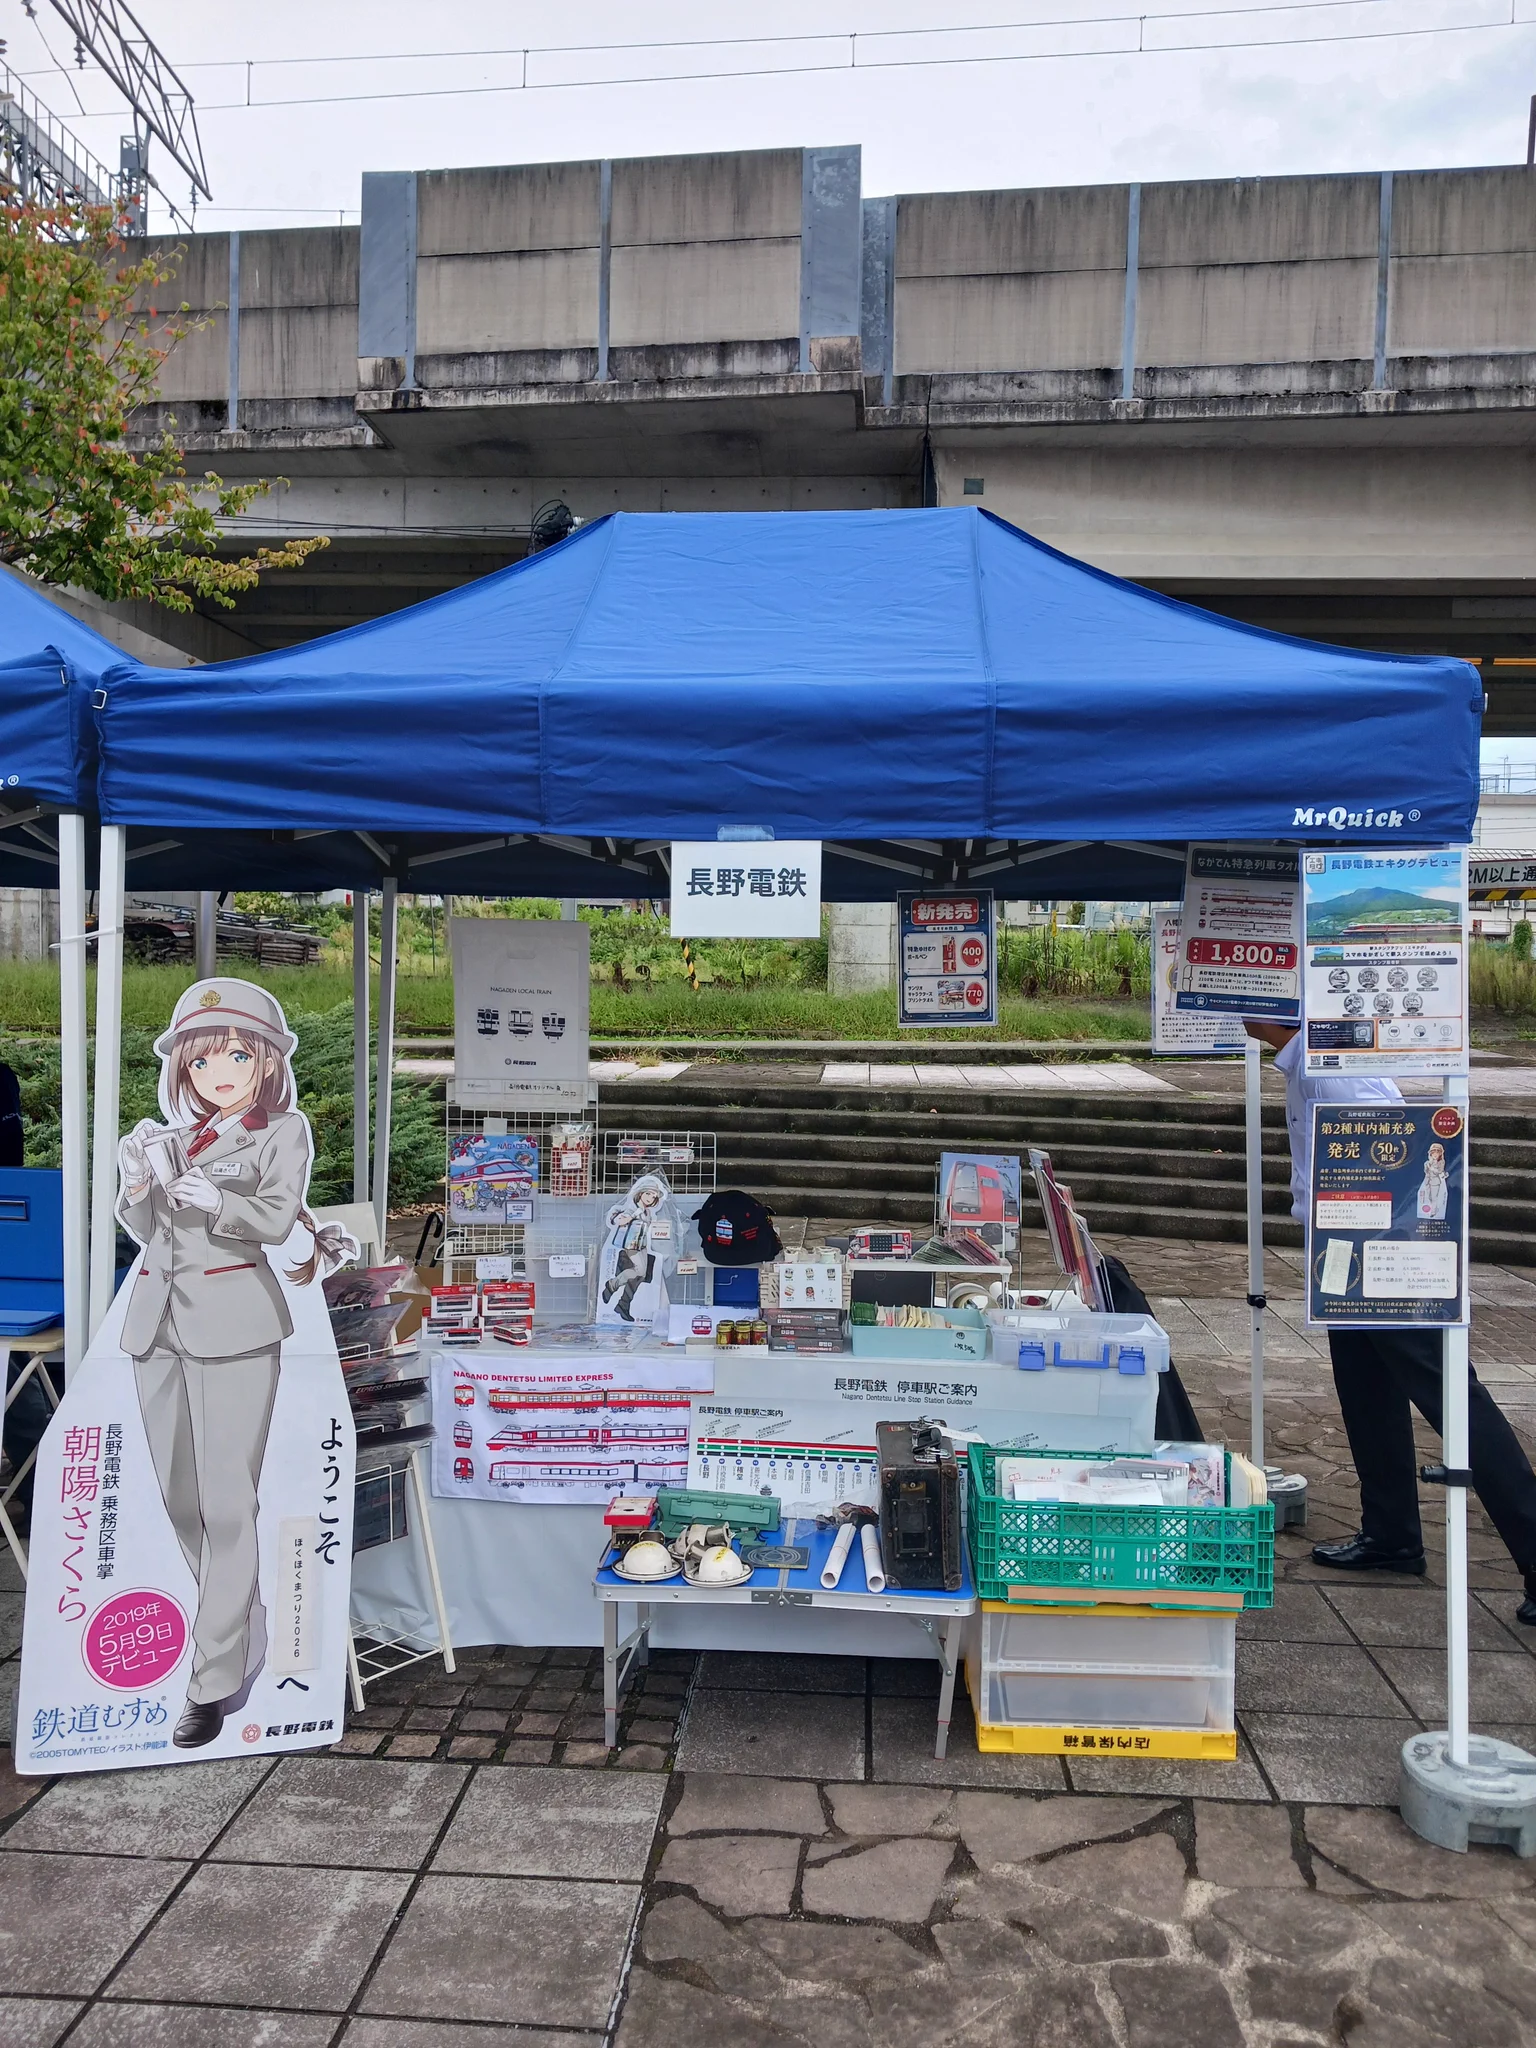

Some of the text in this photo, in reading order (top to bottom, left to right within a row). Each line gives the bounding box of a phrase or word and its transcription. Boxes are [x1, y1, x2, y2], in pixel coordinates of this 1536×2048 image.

[1292, 806, 1404, 830] MrQuick
[1331, 858, 1461, 870] 長野電鉄エキタグデビュー
[686, 867, 807, 897] 長野電鉄
[1469, 866, 1536, 884] M以上通
[917, 903, 973, 921] 新発売
[962, 947, 982, 956] 400
[967, 989, 982, 997] 770
[1321, 1121, 1416, 1136] 第2種車内補充券
[497, 1142, 530, 1150] NAGADEN
[1327, 1140, 1360, 1160] 発売
[453, 1370, 613, 1383] NAGANO DENTETSU LIMITED EXPRESS
[834, 1378, 978, 1397] 長野電鉄 停車駅ご案内
[841, 1393, 863, 1401] Nagano
[893, 1395, 906, 1403] Line
[907, 1395, 922, 1404] Stop
[946, 1398, 973, 1406] Guidance
[698, 1406, 732, 1415] 長野電鉄
[734, 1407, 784, 1417] 停車駅ご案内
[702, 1464, 710, 1479] 長野
[314, 1417, 343, 1566] ようこそ
[96, 1423, 123, 1580] 長野電鉄 乗務区車掌
[57, 1425, 102, 1623] 朝陽さくら
[292, 1537, 304, 1658] ほくほくまつり2026
[102, 1601, 162, 1632] 2019年
[98, 1622, 173, 1657] 5月9日
[100, 1645, 178, 1677] デビュー
[276, 1676, 309, 1692] へ
[32, 1697, 167, 1750] 鉄道むすめ
[266, 1719, 334, 1737] 長野電鉄
[1063, 1735, 1151, 1750] 店内保管箱
